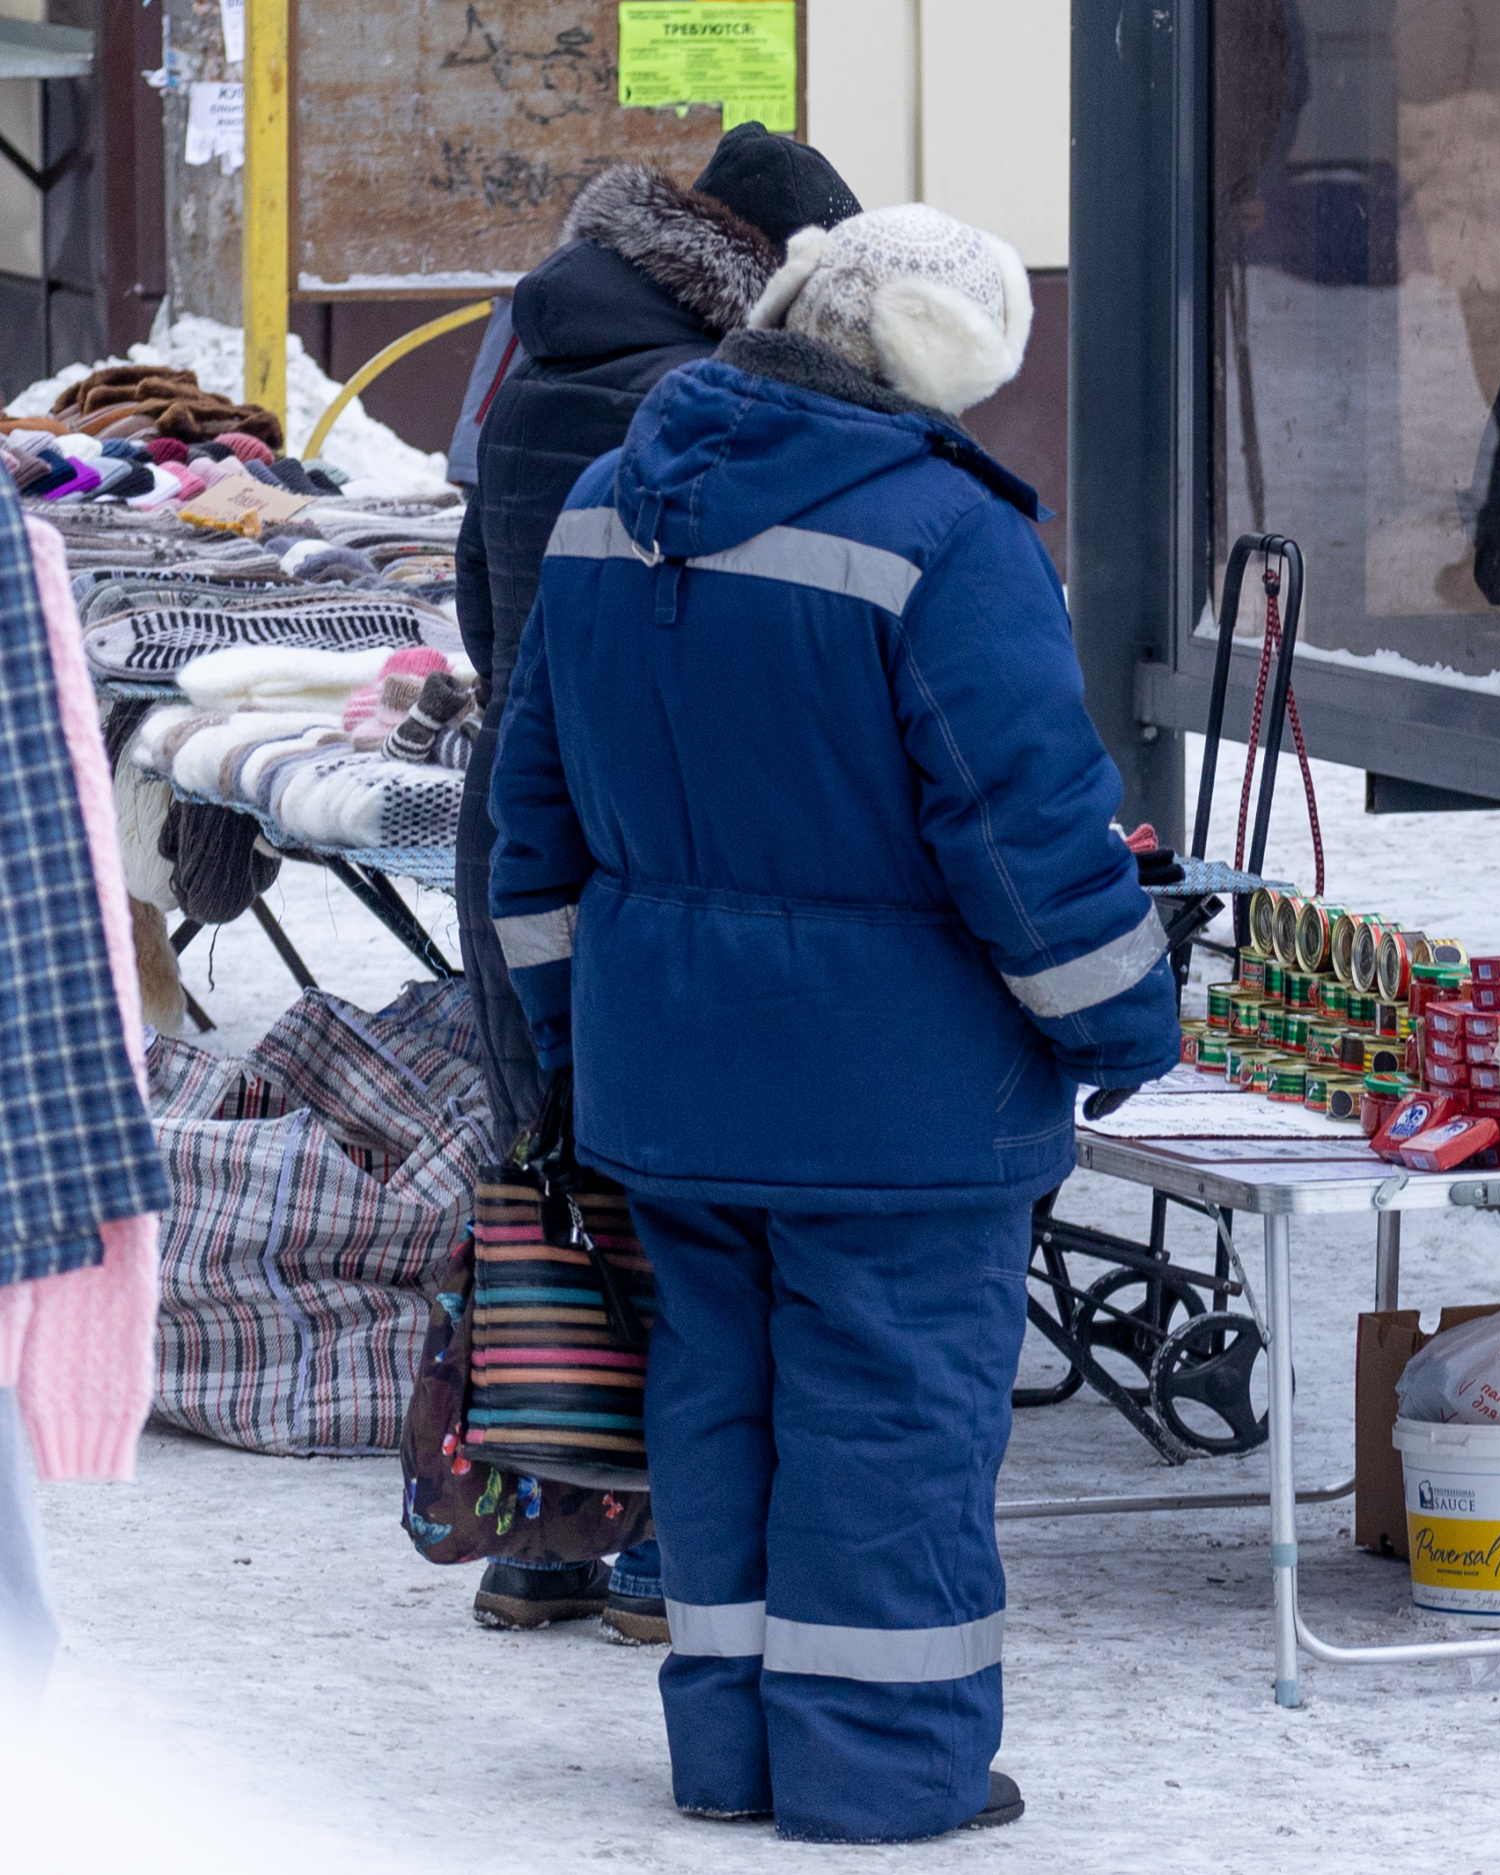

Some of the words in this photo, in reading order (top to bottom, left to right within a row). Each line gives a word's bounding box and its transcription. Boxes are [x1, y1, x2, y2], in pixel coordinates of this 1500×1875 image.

[663, 23, 756, 36] ТРЕБУЮТСЯ:
[1472, 1394, 1498, 1420] для
[1434, 1497, 1476, 1512] SAUCE
